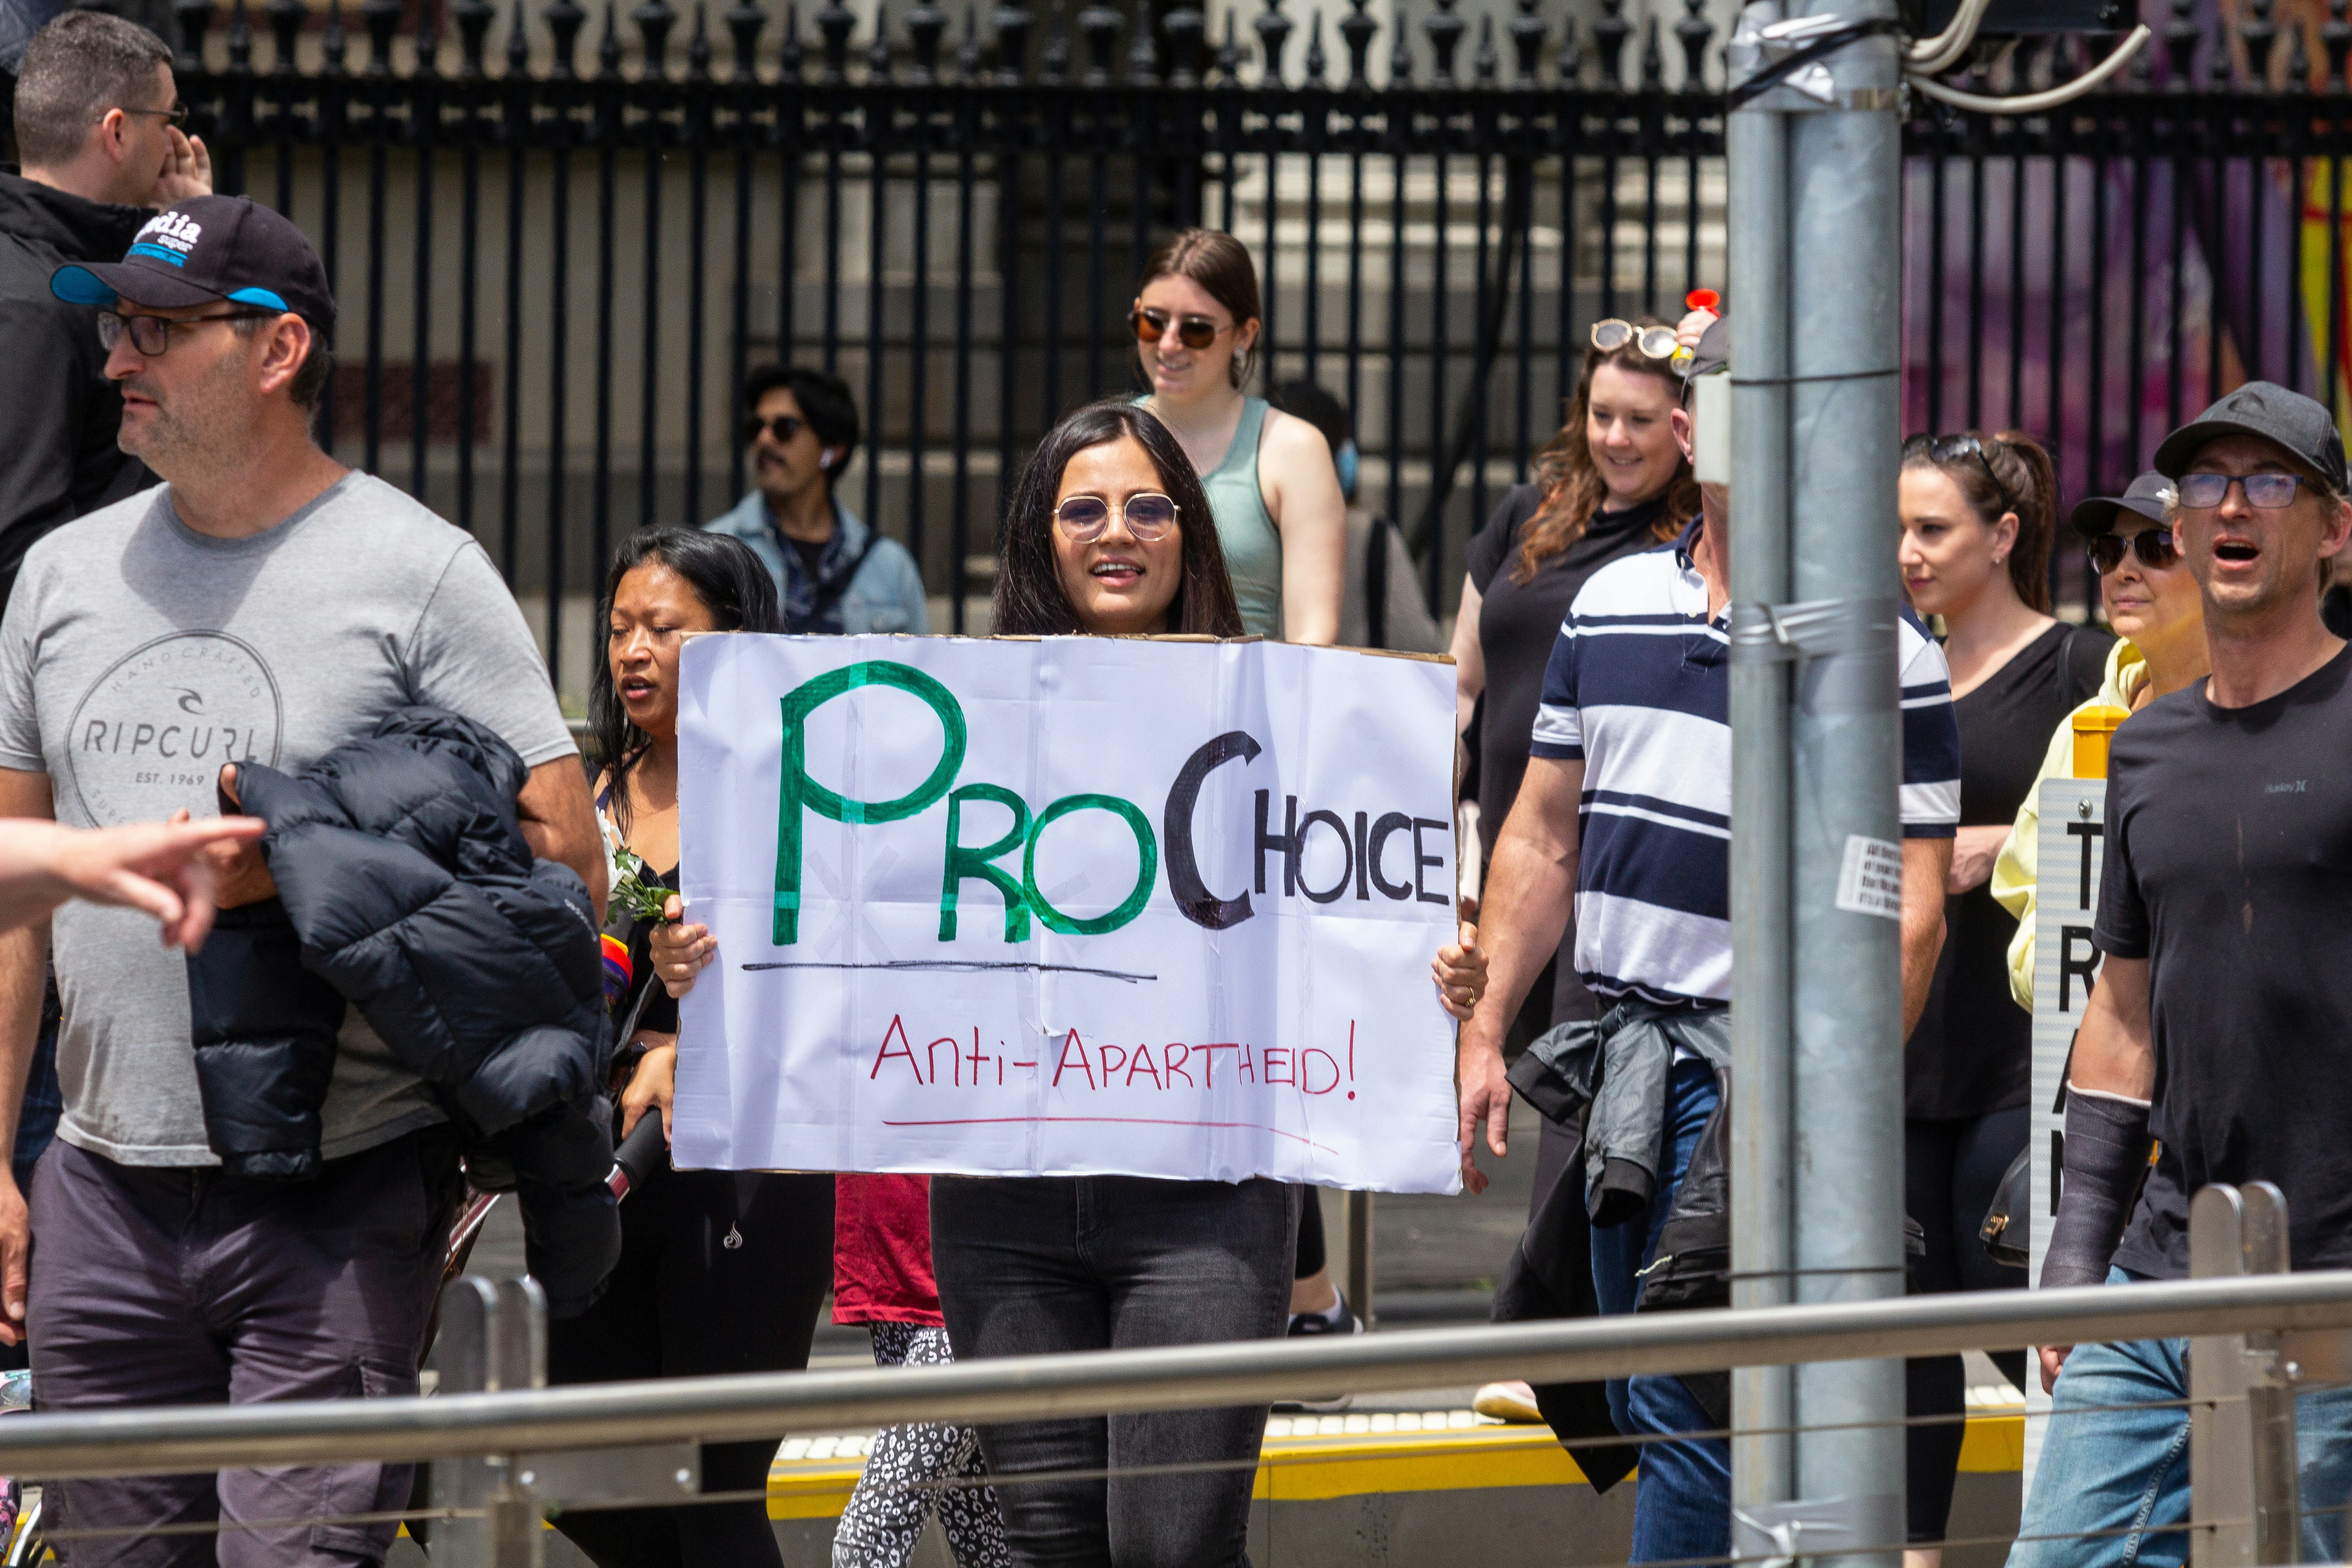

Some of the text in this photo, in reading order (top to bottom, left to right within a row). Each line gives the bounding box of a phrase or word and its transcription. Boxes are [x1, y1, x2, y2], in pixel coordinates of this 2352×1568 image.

[135, 772, 205, 786] EST. 1969
[772, 660, 1450, 946] PRO CHOICE
[2049, 822, 2104, 1217] TR
